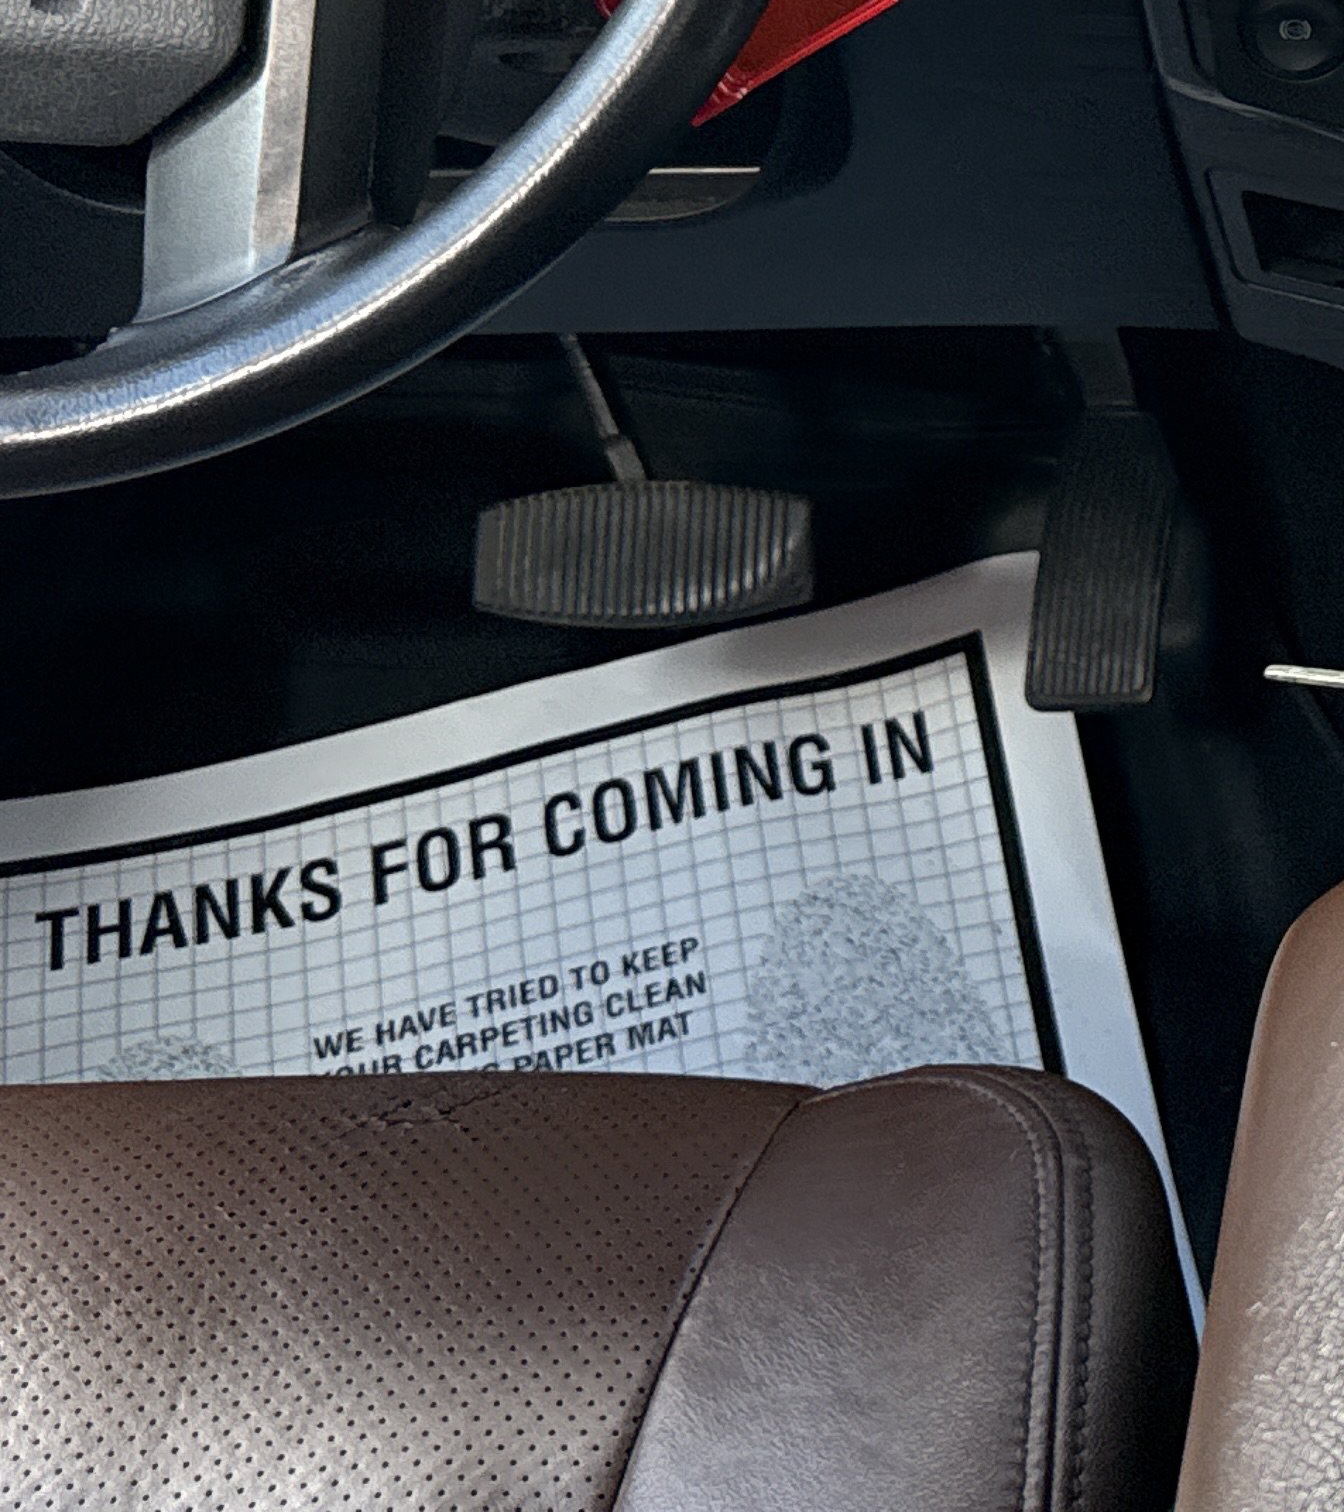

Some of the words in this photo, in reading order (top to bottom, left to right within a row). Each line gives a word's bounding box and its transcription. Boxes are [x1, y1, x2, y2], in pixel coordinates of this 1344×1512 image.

[35, 858, 342, 970] THANKS
[371, 813, 516, 905] FOR
[544, 733, 836, 857] COMING
[861, 710, 934, 785] IN
[314, 1028, 365, 1059] WE
[376, 1001, 457, 1044] HAVE
[466, 974, 559, 1019] TRIED
[568, 960, 610, 991] TO
[622, 937, 699, 977] KEEP
[415, 1000, 594, 1071] CARPETING
[605, 971, 707, 1020] CLEAN
[512, 1032, 616, 1072] PAPER
[626, 1009, 693, 1052] MAT
